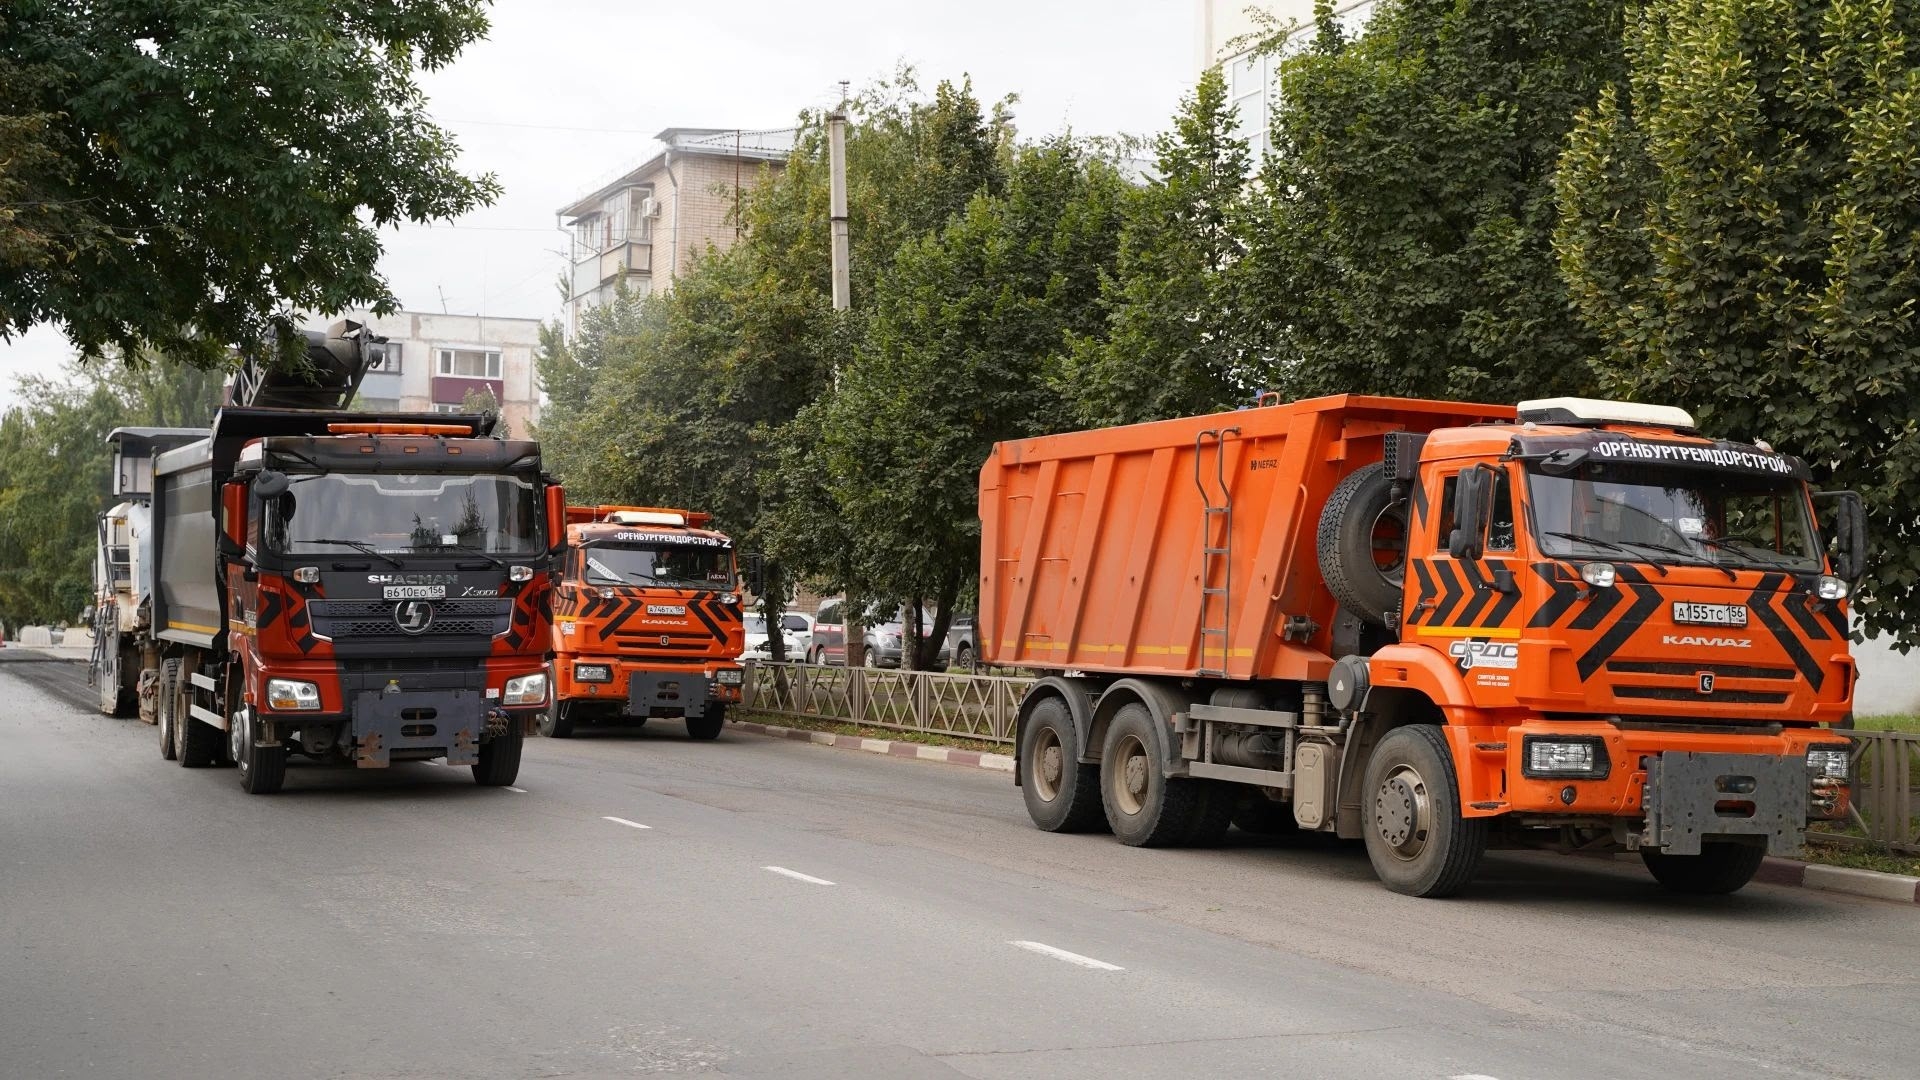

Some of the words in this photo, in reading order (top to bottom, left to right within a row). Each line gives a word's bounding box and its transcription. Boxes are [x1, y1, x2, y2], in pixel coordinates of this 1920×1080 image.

[1593, 441, 1792, 474] «ОРЕНБУРГРЕМДОРСТРОЙ»
[1257, 459, 1278, 469] NEFAZ
[722, 539, 732, 549] Z
[367, 574, 459, 585] SHACMAN
[461, 586, 498, 597] X3000
[1662, 635, 1752, 648] KAMAZ
